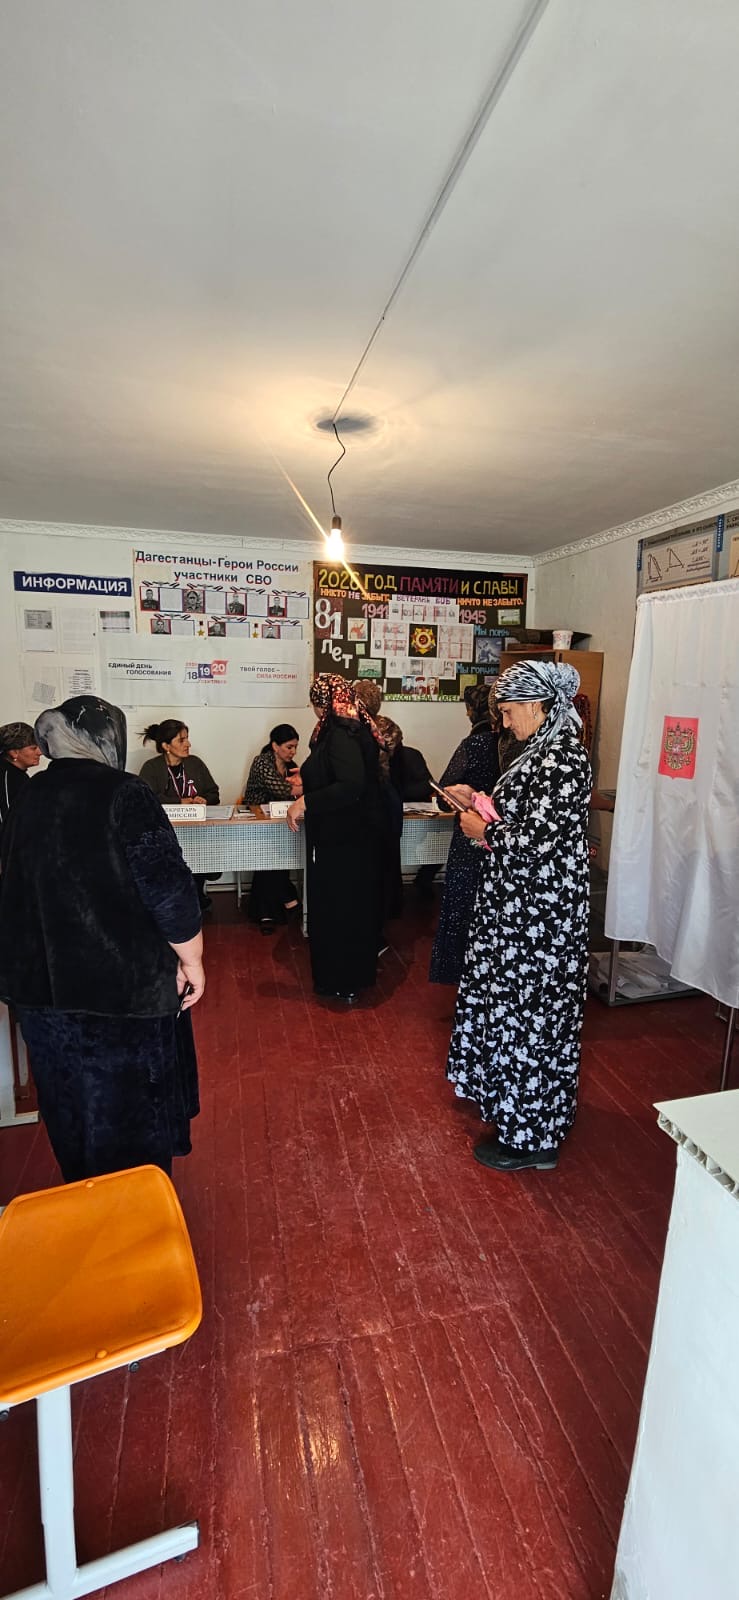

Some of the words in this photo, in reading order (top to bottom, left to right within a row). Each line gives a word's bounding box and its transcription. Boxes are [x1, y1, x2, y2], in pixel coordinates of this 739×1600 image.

[135, 550, 253, 570] Дагестанцы-Герои
[256, 560, 299, 573] России
[22, 576, 128, 593] ИНФОРМАЦИЯ
[173, 570, 238, 582] участники
[245, 574, 273, 585] СВО
[318, 568, 360, 591] 2026
[364, 573, 398, 592] ГОД
[400, 576, 459, 593] ПАМЯТИ
[473, 579, 518, 595] СЛАВЫ
[320, 588, 347, 598] НИКТО
[348, 591, 360, 600] НЕ
[456, 597, 481, 606] НИЧТО
[482, 598, 493, 607] НЕ
[314, 598, 344, 639] 81
[361, 603, 389, 619] 1941
[459, 608, 487, 625] 1945
[186, 671, 198, 680] 18
[199, 667, 211, 676] 19
[212, 663, 226, 673] 20
